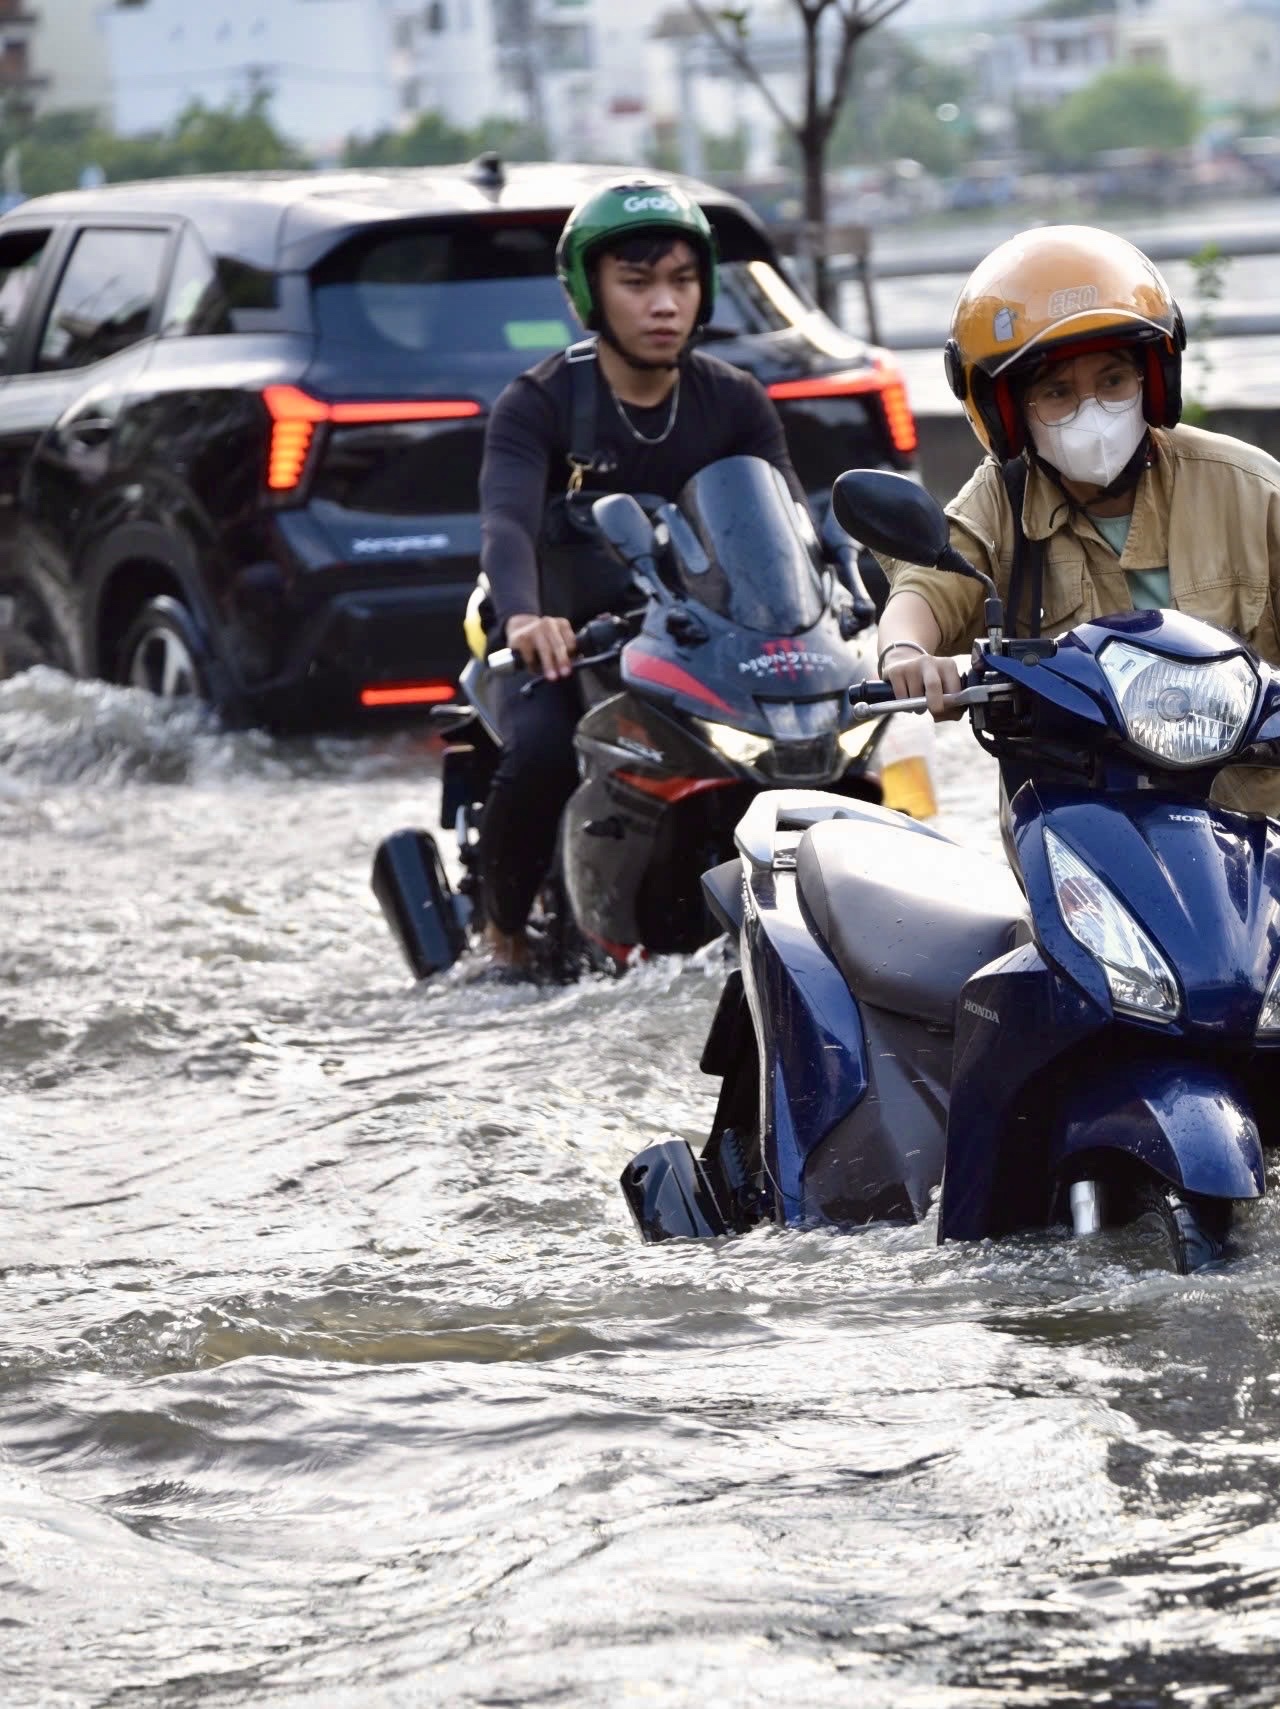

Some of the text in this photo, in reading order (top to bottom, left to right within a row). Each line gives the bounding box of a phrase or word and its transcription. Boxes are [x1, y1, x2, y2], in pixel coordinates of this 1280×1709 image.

[623, 195, 678, 212] Grab
[738, 651, 838, 673] MONSTER
[1168, 814, 1227, 830] HONDA
[964, 999, 1000, 1024] HONDA
